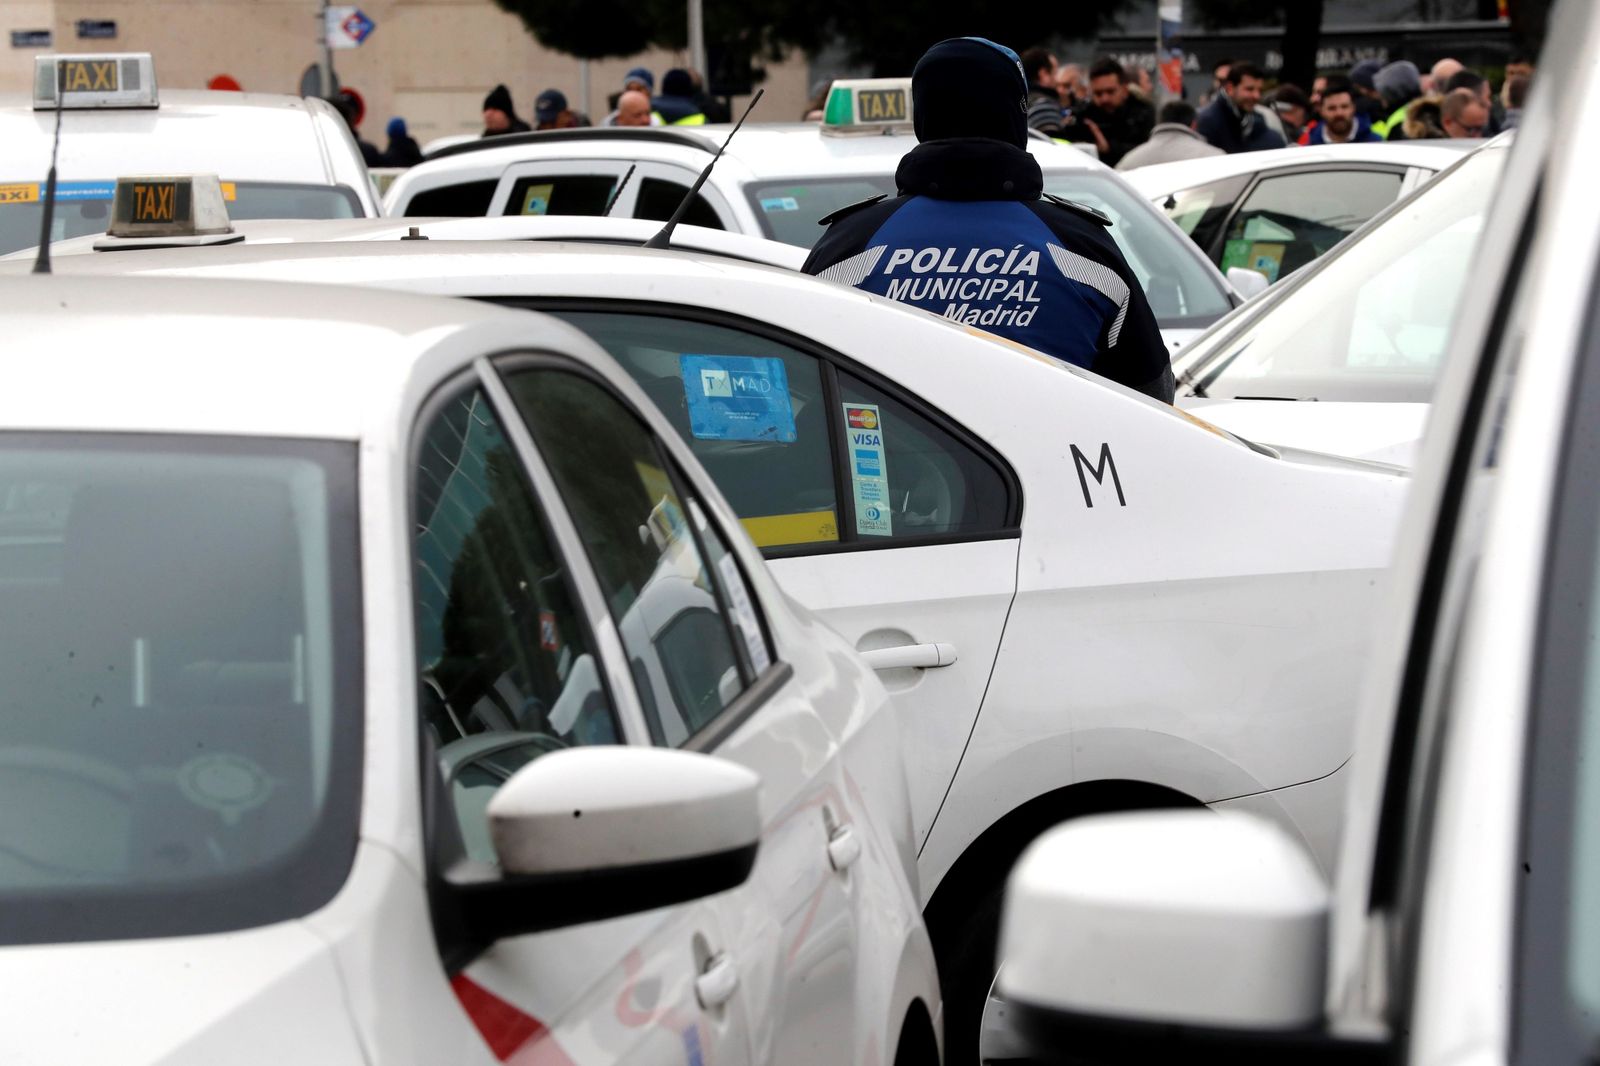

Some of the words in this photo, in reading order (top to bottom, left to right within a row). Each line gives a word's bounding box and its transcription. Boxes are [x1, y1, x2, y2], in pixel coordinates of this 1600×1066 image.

[60, 63, 117, 90] TAXI
[860, 93, 905, 118] TAXI
[134, 186, 174, 219] TAXI
[884, 244, 1040, 275] POLICÍA
[885, 277, 1041, 302] MUNICIPAL
[943, 302, 1038, 327] Madrid
[853, 433, 880, 446] VISA
[1069, 442, 1126, 508] M
